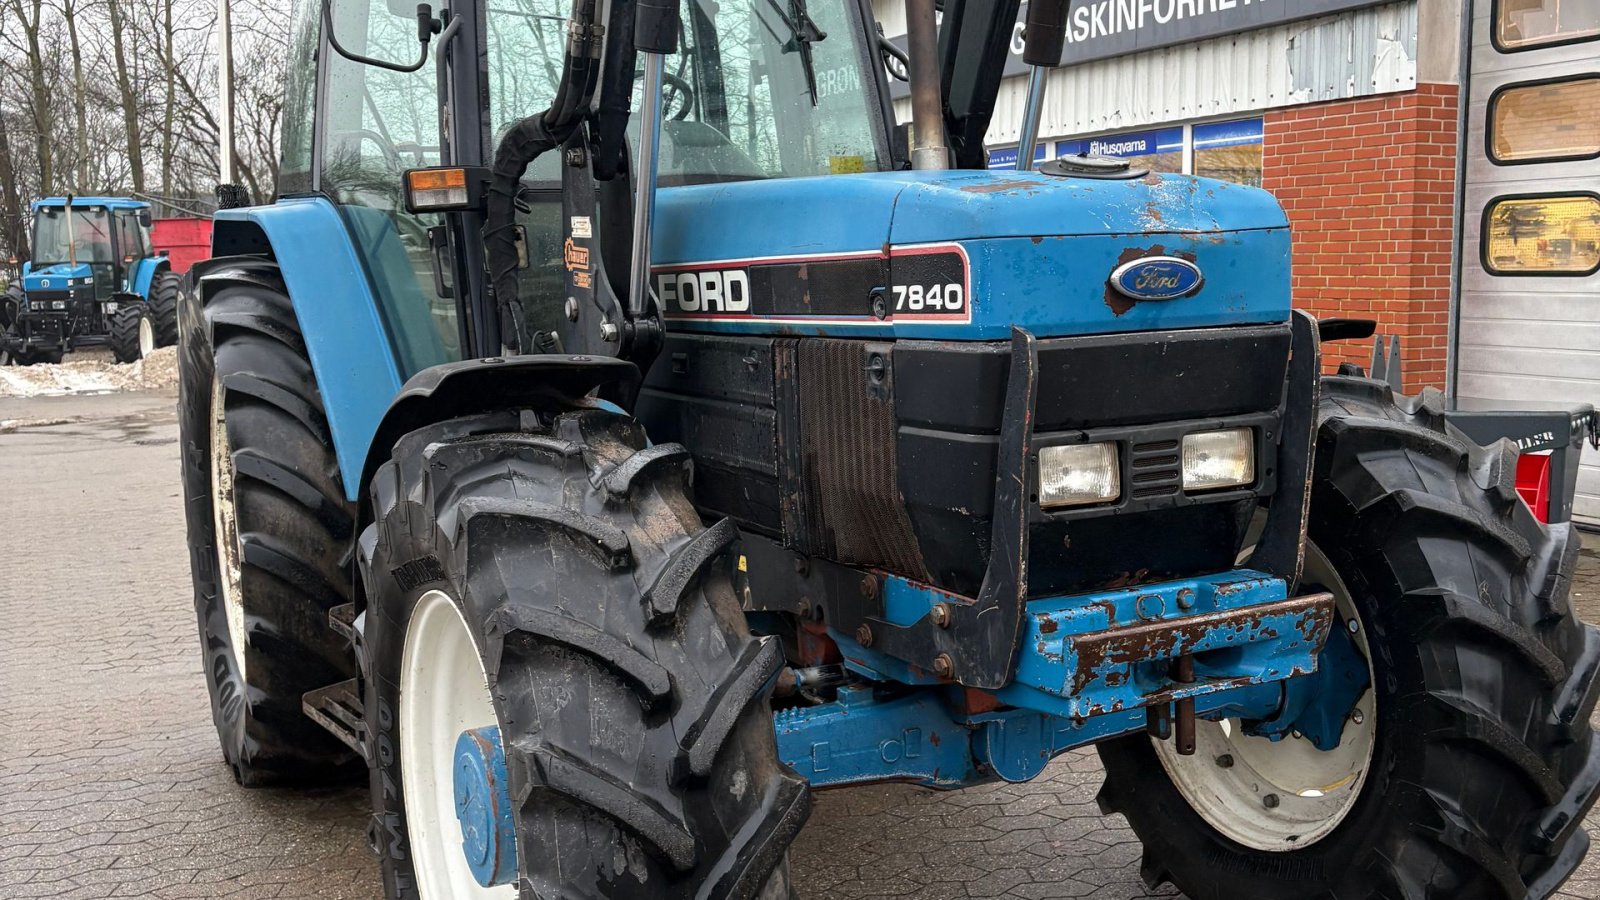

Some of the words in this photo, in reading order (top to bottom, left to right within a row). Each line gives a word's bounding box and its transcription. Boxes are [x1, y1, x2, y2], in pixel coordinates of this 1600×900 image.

[1099, 139, 1146, 156] Husqvarna
[658, 269, 750, 312] FORD
[1136, 265, 1182, 290] Ford
[892, 283, 963, 310] 7840
